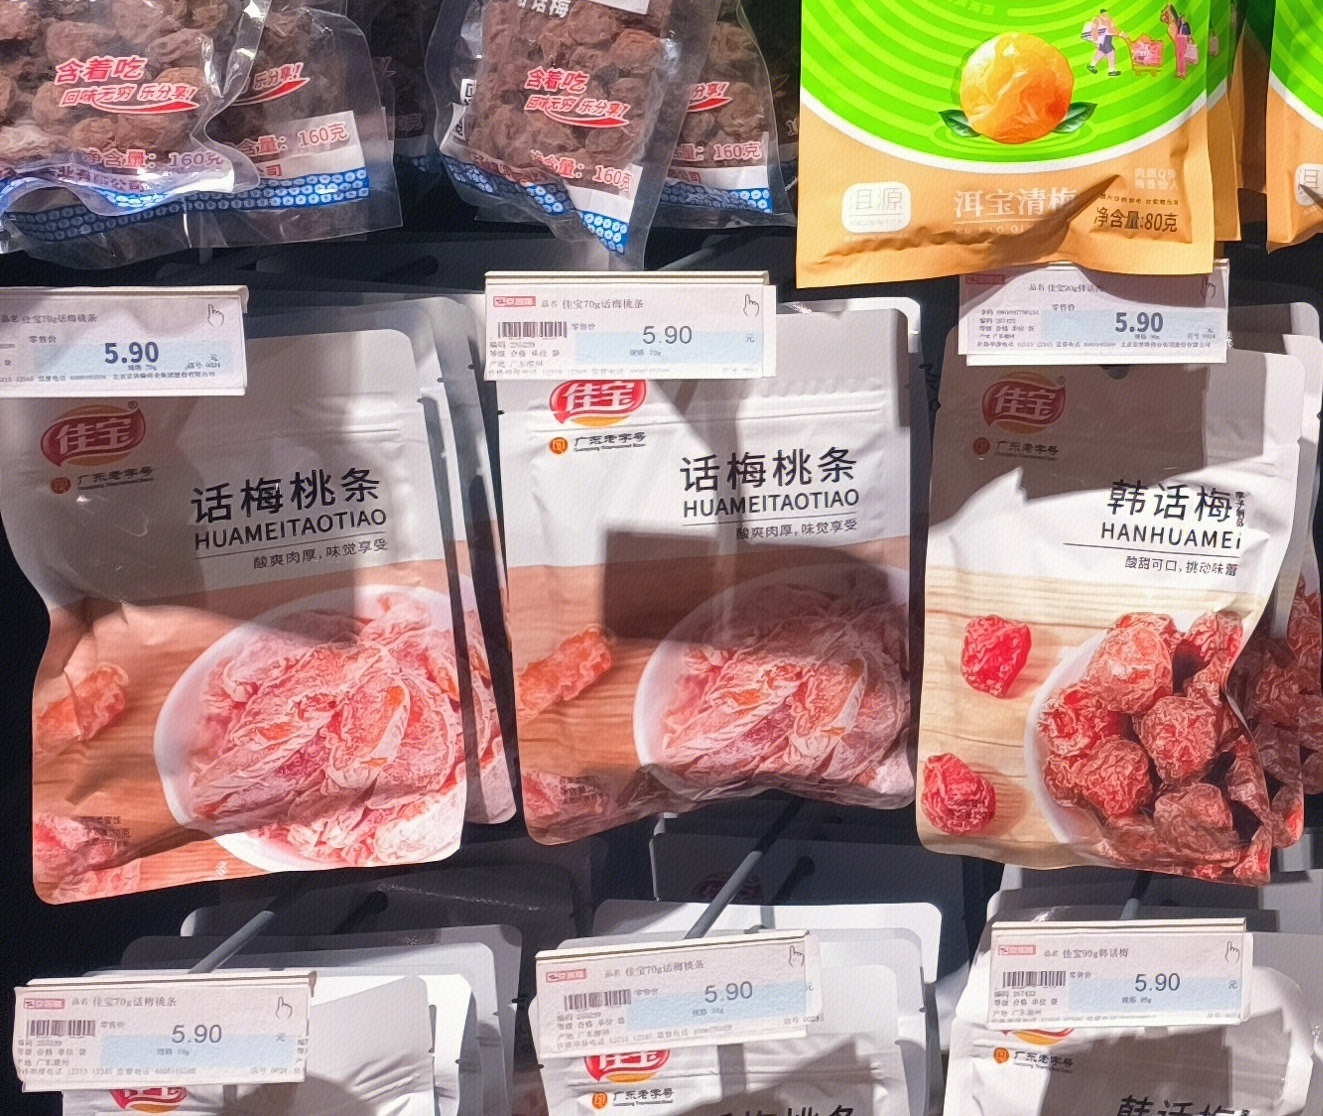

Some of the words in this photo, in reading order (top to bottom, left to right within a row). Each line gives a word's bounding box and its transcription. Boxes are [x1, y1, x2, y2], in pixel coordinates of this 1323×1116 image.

[54, 55, 148, 84] 含着吃
[523, 66, 590, 94] 含着吃
[59, 85, 135, 108] 回味无穷
[1094, 204, 1179, 234] 净含量:80克
[642, 324, 693, 346] 5.90
[1114, 311, 1165, 334] 5.90
[104, 339, 161, 365] 5.90
[558, 380, 640, 419] 佳宝
[991, 383, 1058, 425] 佳宝
[54, 412, 141, 457] 佳宝
[679, 445, 858, 495] 话梅桃条
[189, 467, 383, 526] 话梅桃条
[682, 488, 861, 520] HUAMEITAOTIAO
[1105, 478, 1234, 524] 韩话梅
[193, 507, 389, 552] HUAMEITAOTIAO
[1099, 521, 1243, 551] HANHUAMEI
[704, 980, 754, 1004] 5.90
[1134, 972, 1182, 992] 5.90
[170, 1022, 223, 1045] 5.90
